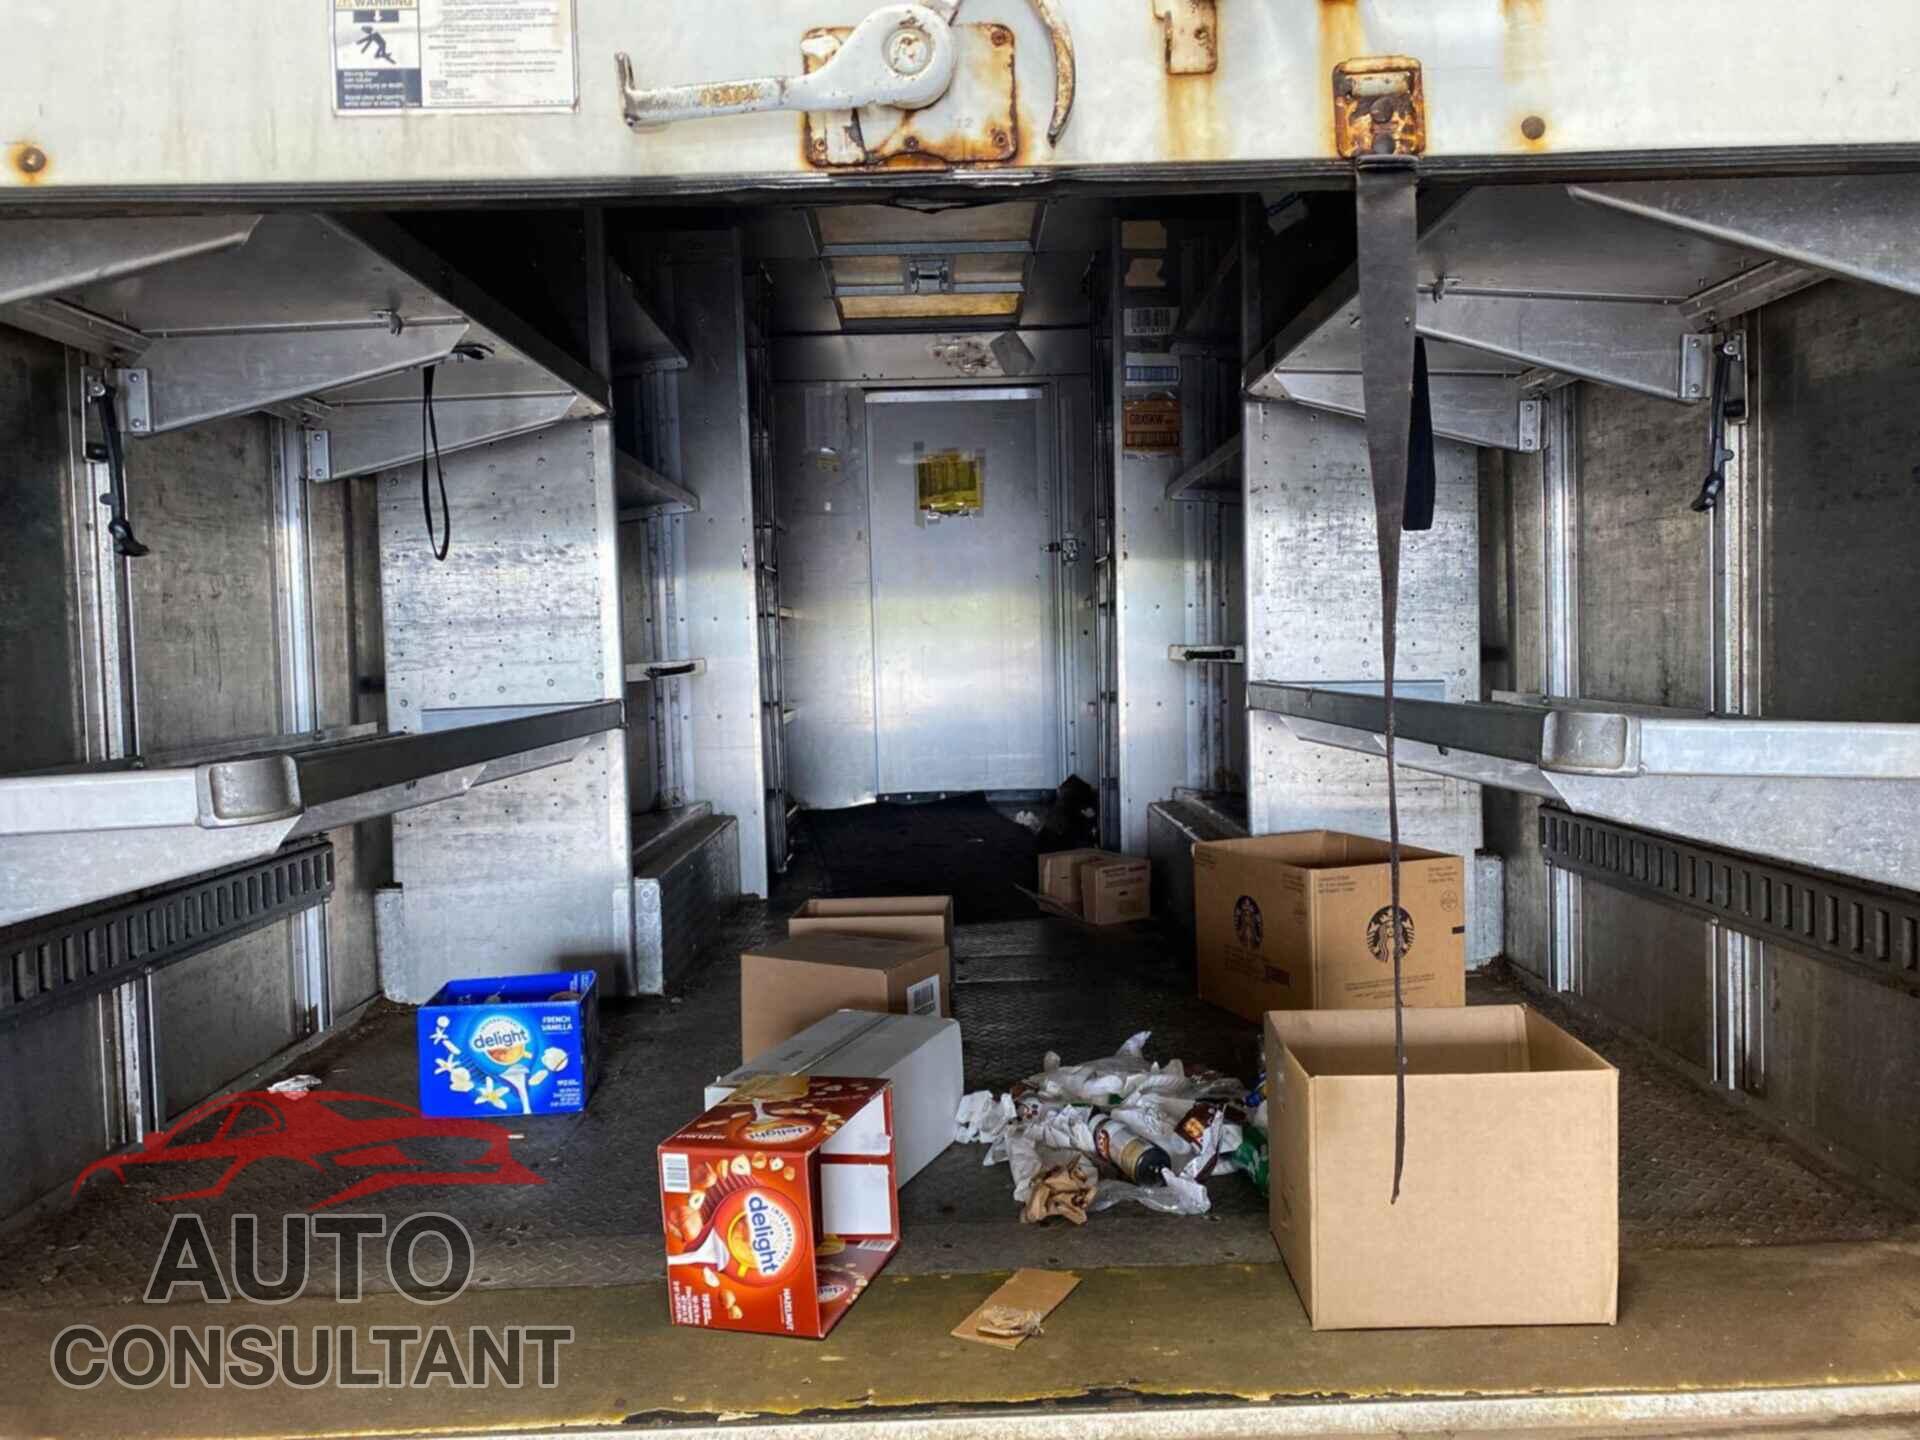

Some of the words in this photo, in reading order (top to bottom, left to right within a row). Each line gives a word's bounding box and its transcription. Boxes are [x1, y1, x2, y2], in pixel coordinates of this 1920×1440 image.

[541, 1016, 571, 1024] FRENCH
[541, 1023, 574, 1032] VANILLA
[474, 1029, 529, 1049] delight
[748, 1196, 779, 1273] delight
[782, 1287, 795, 1332] HAZELNUT
